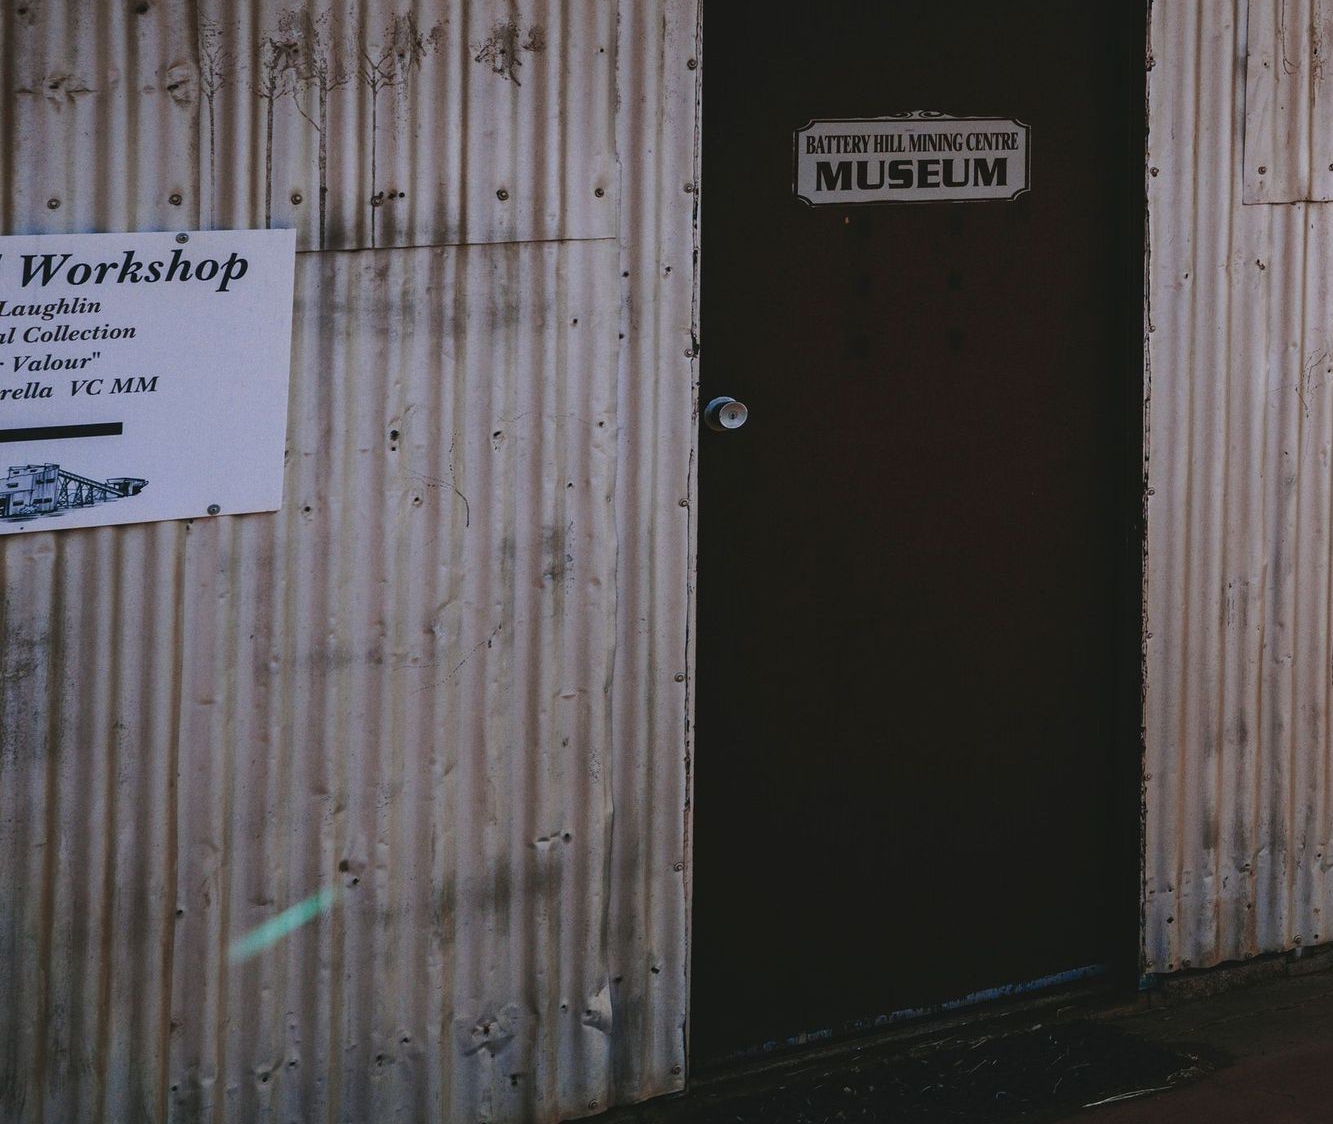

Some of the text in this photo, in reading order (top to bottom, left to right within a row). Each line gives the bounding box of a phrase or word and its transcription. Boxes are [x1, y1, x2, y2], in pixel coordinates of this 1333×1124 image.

[806, 132, 1019, 155] BATTERY HILL MINING CENTRE
[815, 157, 1008, 191] MUSEUM
[20, 249, 249, 292] Workshop
[23, 323, 137, 344] Collection
[13, 352, 101, 373] Valour"
[70, 378, 103, 396] VC
[109, 376, 159, 395] MM
